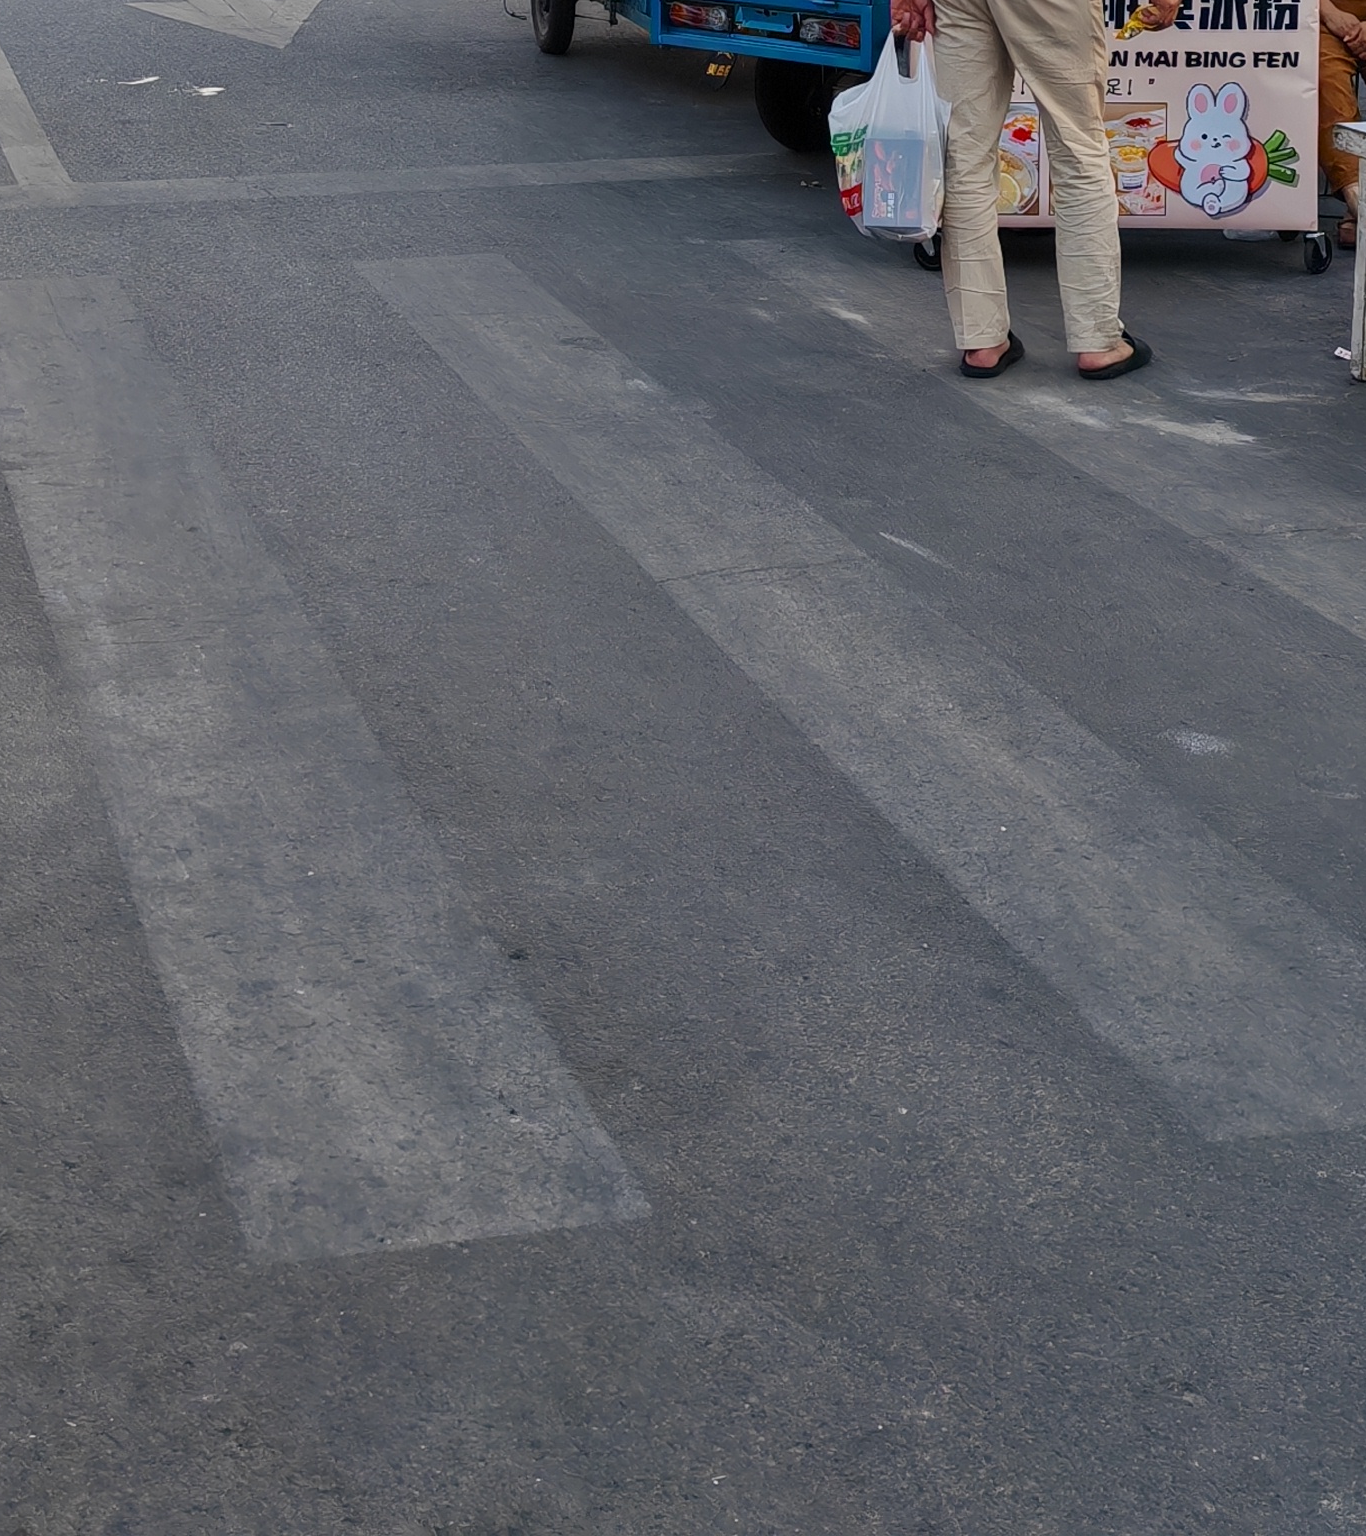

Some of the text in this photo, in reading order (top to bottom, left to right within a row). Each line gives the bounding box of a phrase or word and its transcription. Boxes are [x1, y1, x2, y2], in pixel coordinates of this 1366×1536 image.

[1135, 51, 1178, 68] MAI
[1185, 51, 1247, 68] BING
[1253, 51, 1300, 68] FEN
